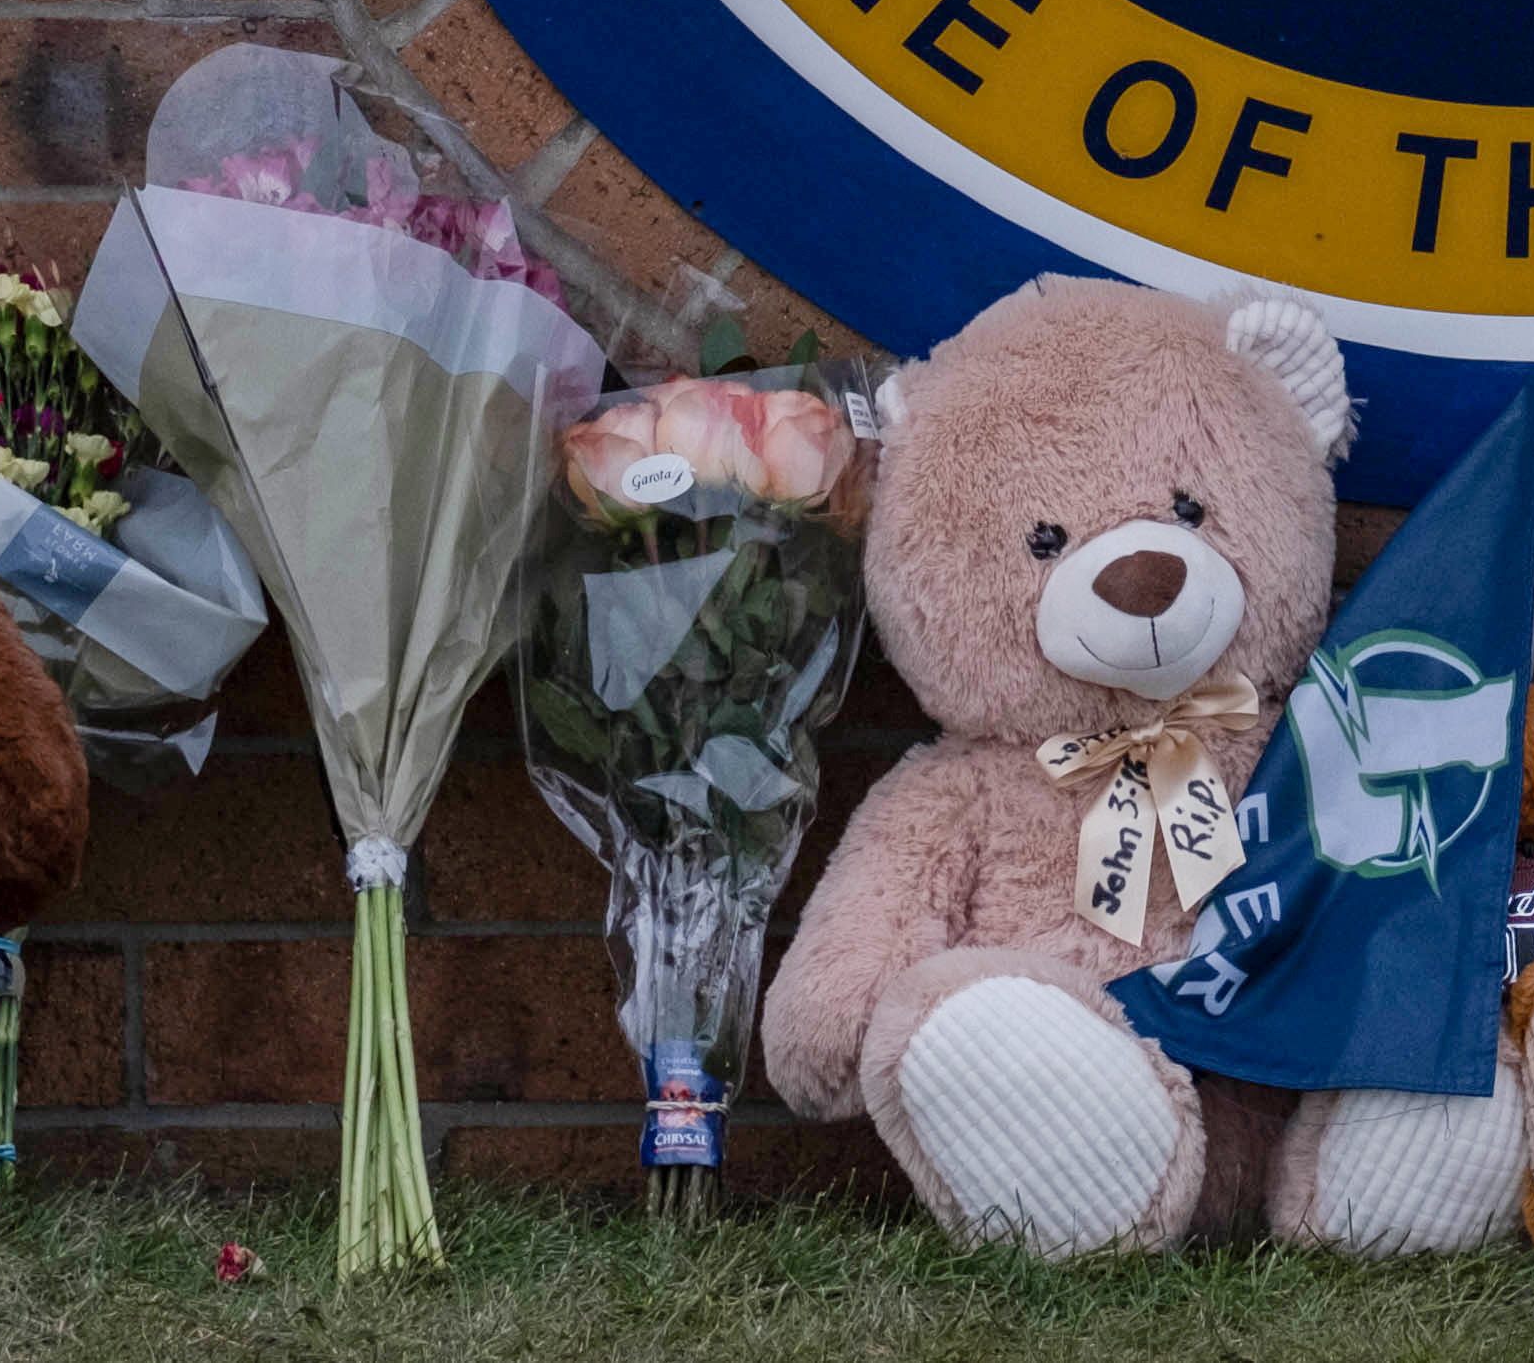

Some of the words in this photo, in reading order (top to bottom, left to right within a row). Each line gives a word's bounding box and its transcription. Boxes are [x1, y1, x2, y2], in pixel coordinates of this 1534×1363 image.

[1082, 59, 1313, 212] OF
[1091, 827, 1143, 916] John
[654, 1133, 708, 1146] CHRYSAL
